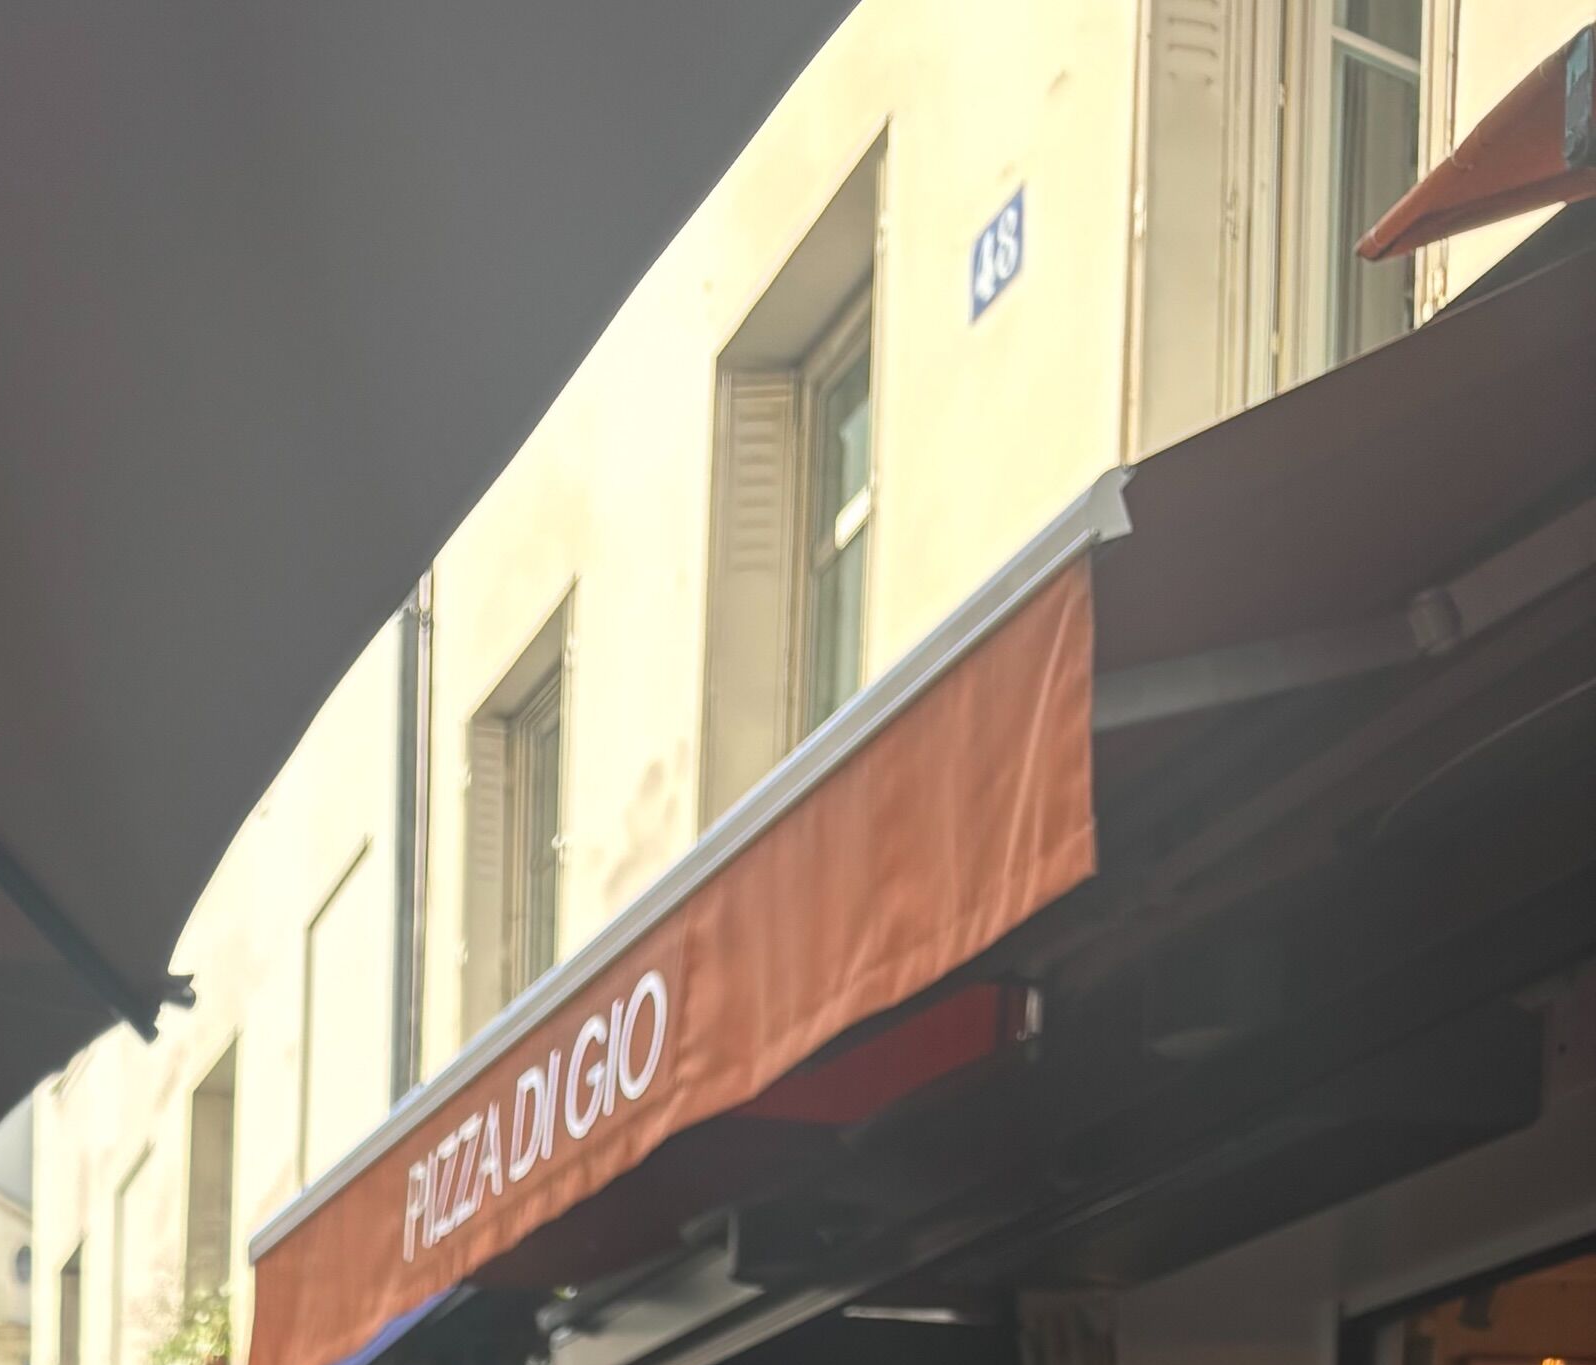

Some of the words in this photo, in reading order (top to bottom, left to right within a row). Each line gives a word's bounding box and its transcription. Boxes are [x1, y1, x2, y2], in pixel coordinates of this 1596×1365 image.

[974, 206, 1019, 303] 48
[404, 1100, 502, 1263] PIZZA
[509, 1048, 561, 1182] DI
[565, 969, 668, 1139] GIO
